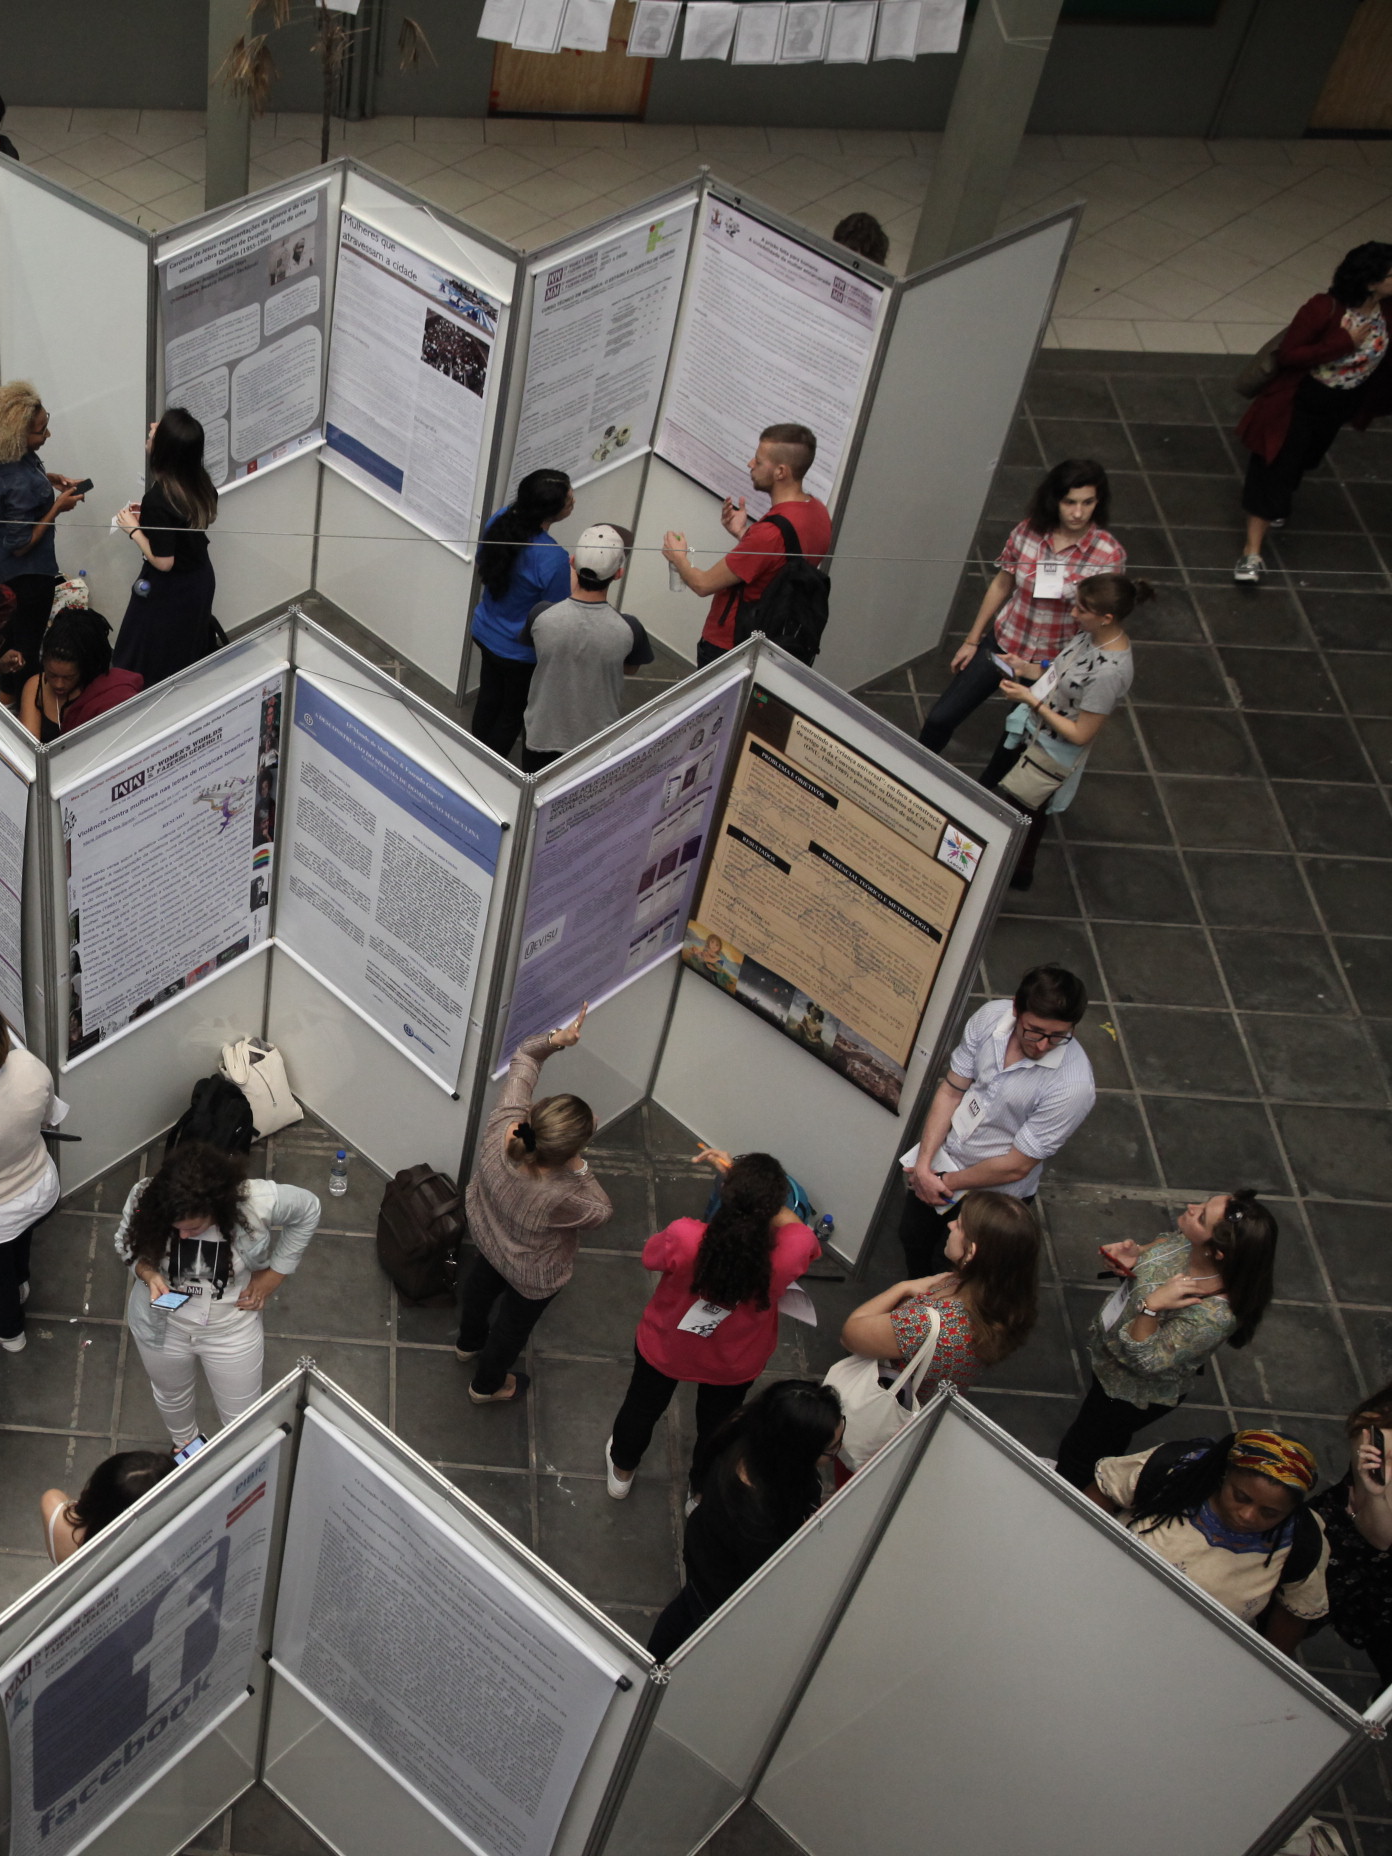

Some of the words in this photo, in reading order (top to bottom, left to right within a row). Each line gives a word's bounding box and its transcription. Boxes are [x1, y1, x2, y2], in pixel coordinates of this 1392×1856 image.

[342, 229, 384, 262] atravessam
[392, 258, 417, 282] cidade
[343, 213, 379, 243] Mulheres
[380, 236, 395, 255] que
[761, 751, 789, 775] PROBLEMA
[77, 815, 106, 840] Violência
[107, 804, 128, 824] contra
[129, 788, 157, 812] mulheres
[159, 783, 170, 794] nas
[37, 1674, 211, 1840] facebook
